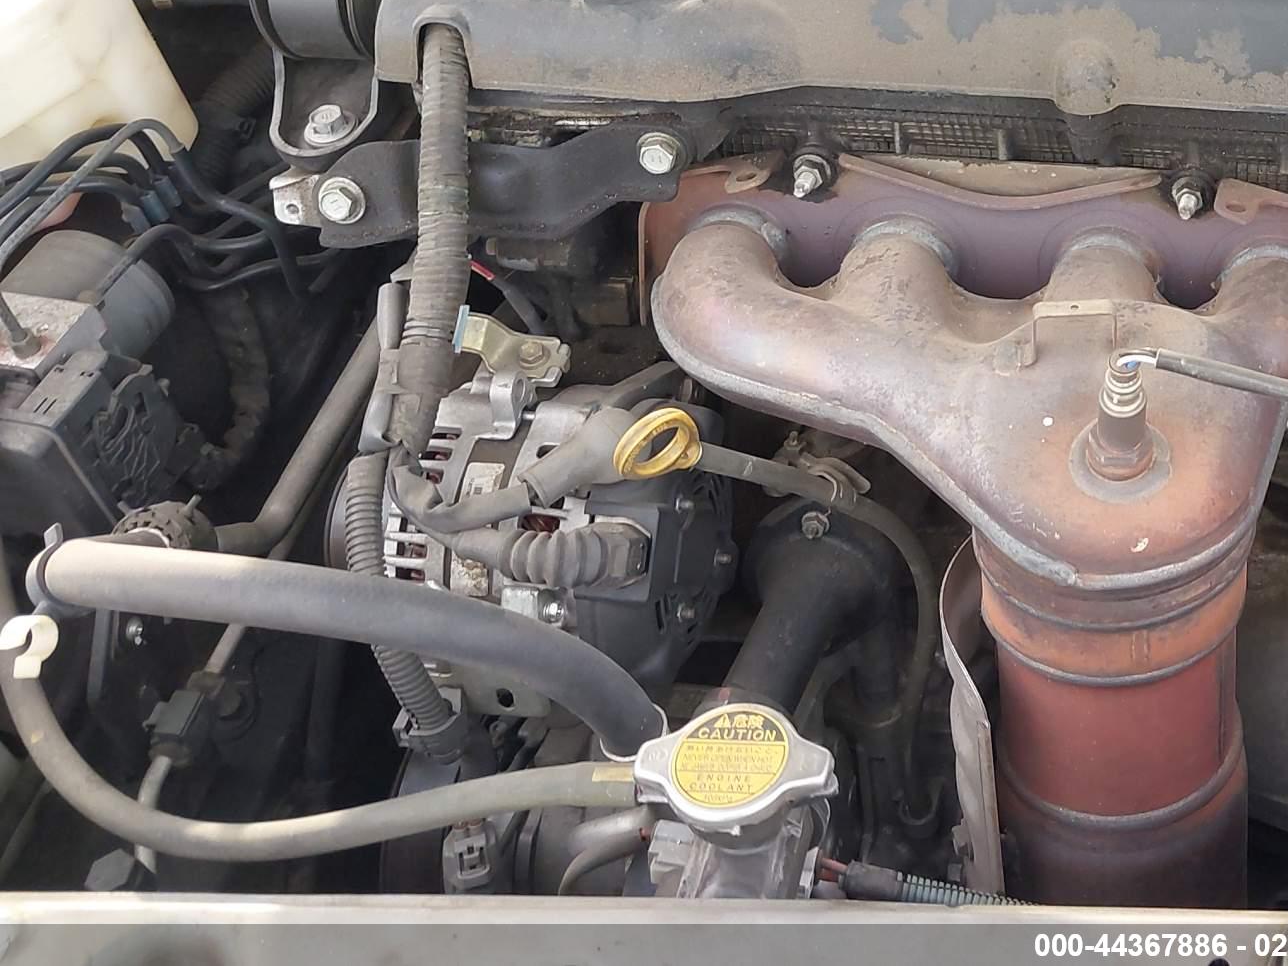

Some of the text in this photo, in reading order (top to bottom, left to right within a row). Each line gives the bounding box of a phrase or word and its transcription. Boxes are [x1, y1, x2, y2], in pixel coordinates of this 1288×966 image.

[698, 727, 777, 741] CAUTION
[696, 774, 752, 783] ENGINE
[688, 782, 754, 792] COOLANT
